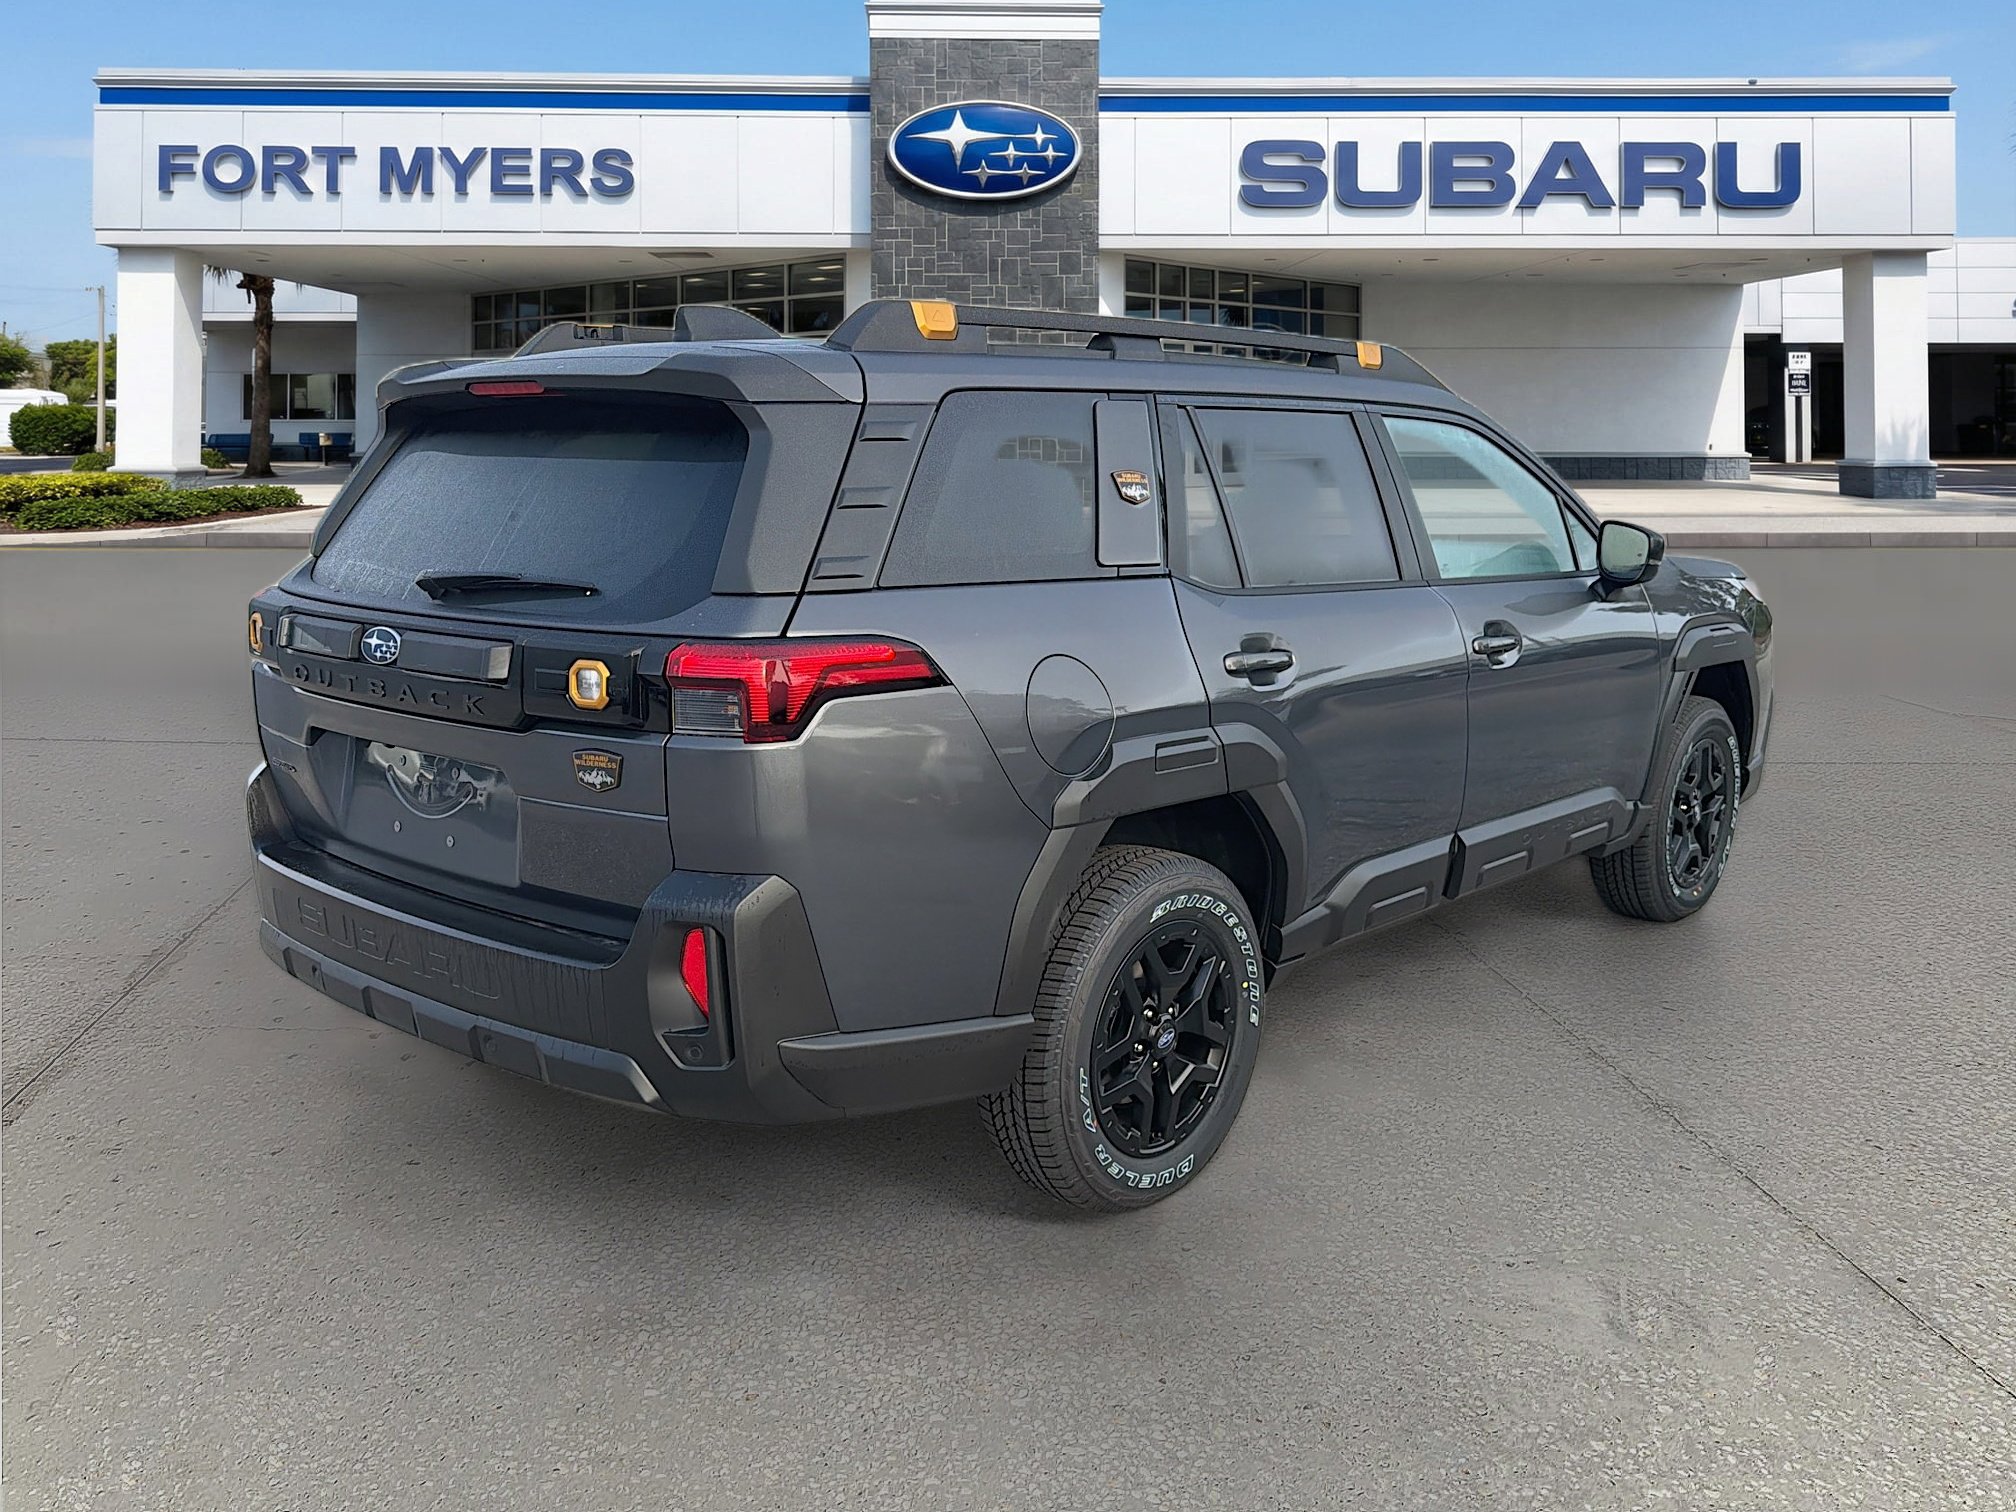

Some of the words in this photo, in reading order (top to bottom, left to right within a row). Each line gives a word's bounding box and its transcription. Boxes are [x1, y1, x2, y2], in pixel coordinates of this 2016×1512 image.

[158, 144, 357, 194] FORT
[379, 146, 635, 197] MYERS
[1239, 139, 1802, 209] SUBARU
[294, 663, 486, 717] OUTBACK
[574, 758, 618, 770] WILDERNESS
[581, 753, 610, 763] SUBARU
[297, 896, 500, 1000] SUBARU
[1149, 894, 1260, 1027] BRIDGESTONE
[1094, 1143, 1195, 1189] DUELER
